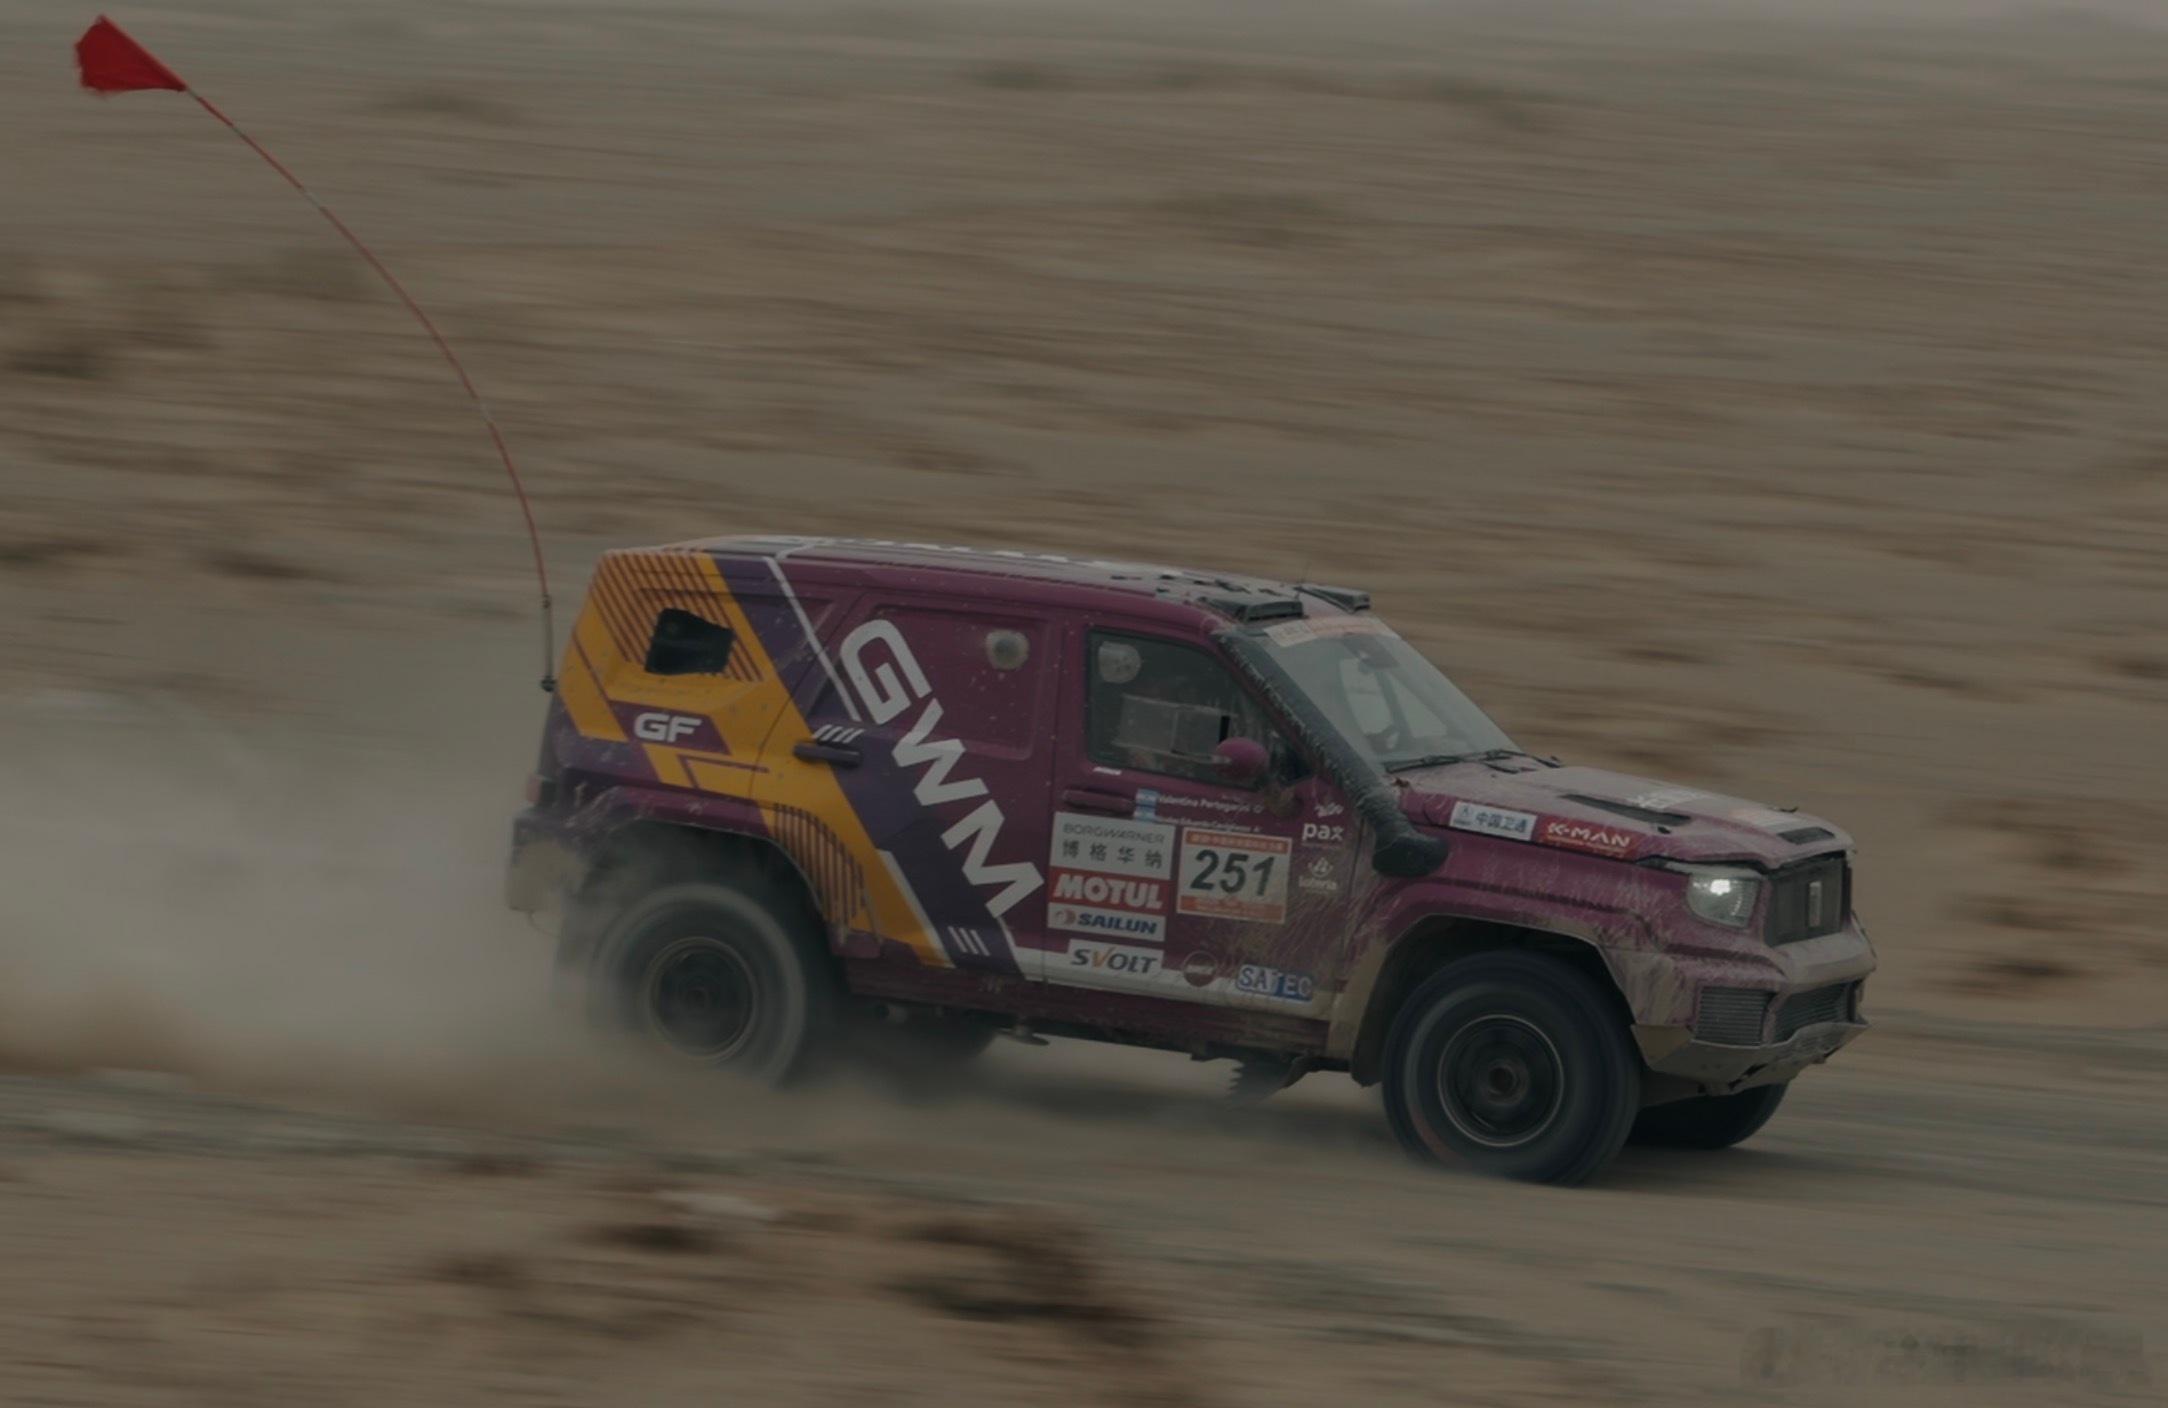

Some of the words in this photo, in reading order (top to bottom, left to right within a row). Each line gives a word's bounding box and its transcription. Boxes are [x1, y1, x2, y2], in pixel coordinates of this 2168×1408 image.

[634, 711, 702, 743] GF
[840, 619, 1045, 919] GWM
[1062, 822, 1165, 843] BORGWARNER
[1302, 823, 1344, 841] pax
[1190, 849, 1275, 896] 251
[1053, 873, 1163, 909] MOTUL
[1078, 912, 1157, 934] SAILUN
[1071, 947, 1157, 974] SVOLT
